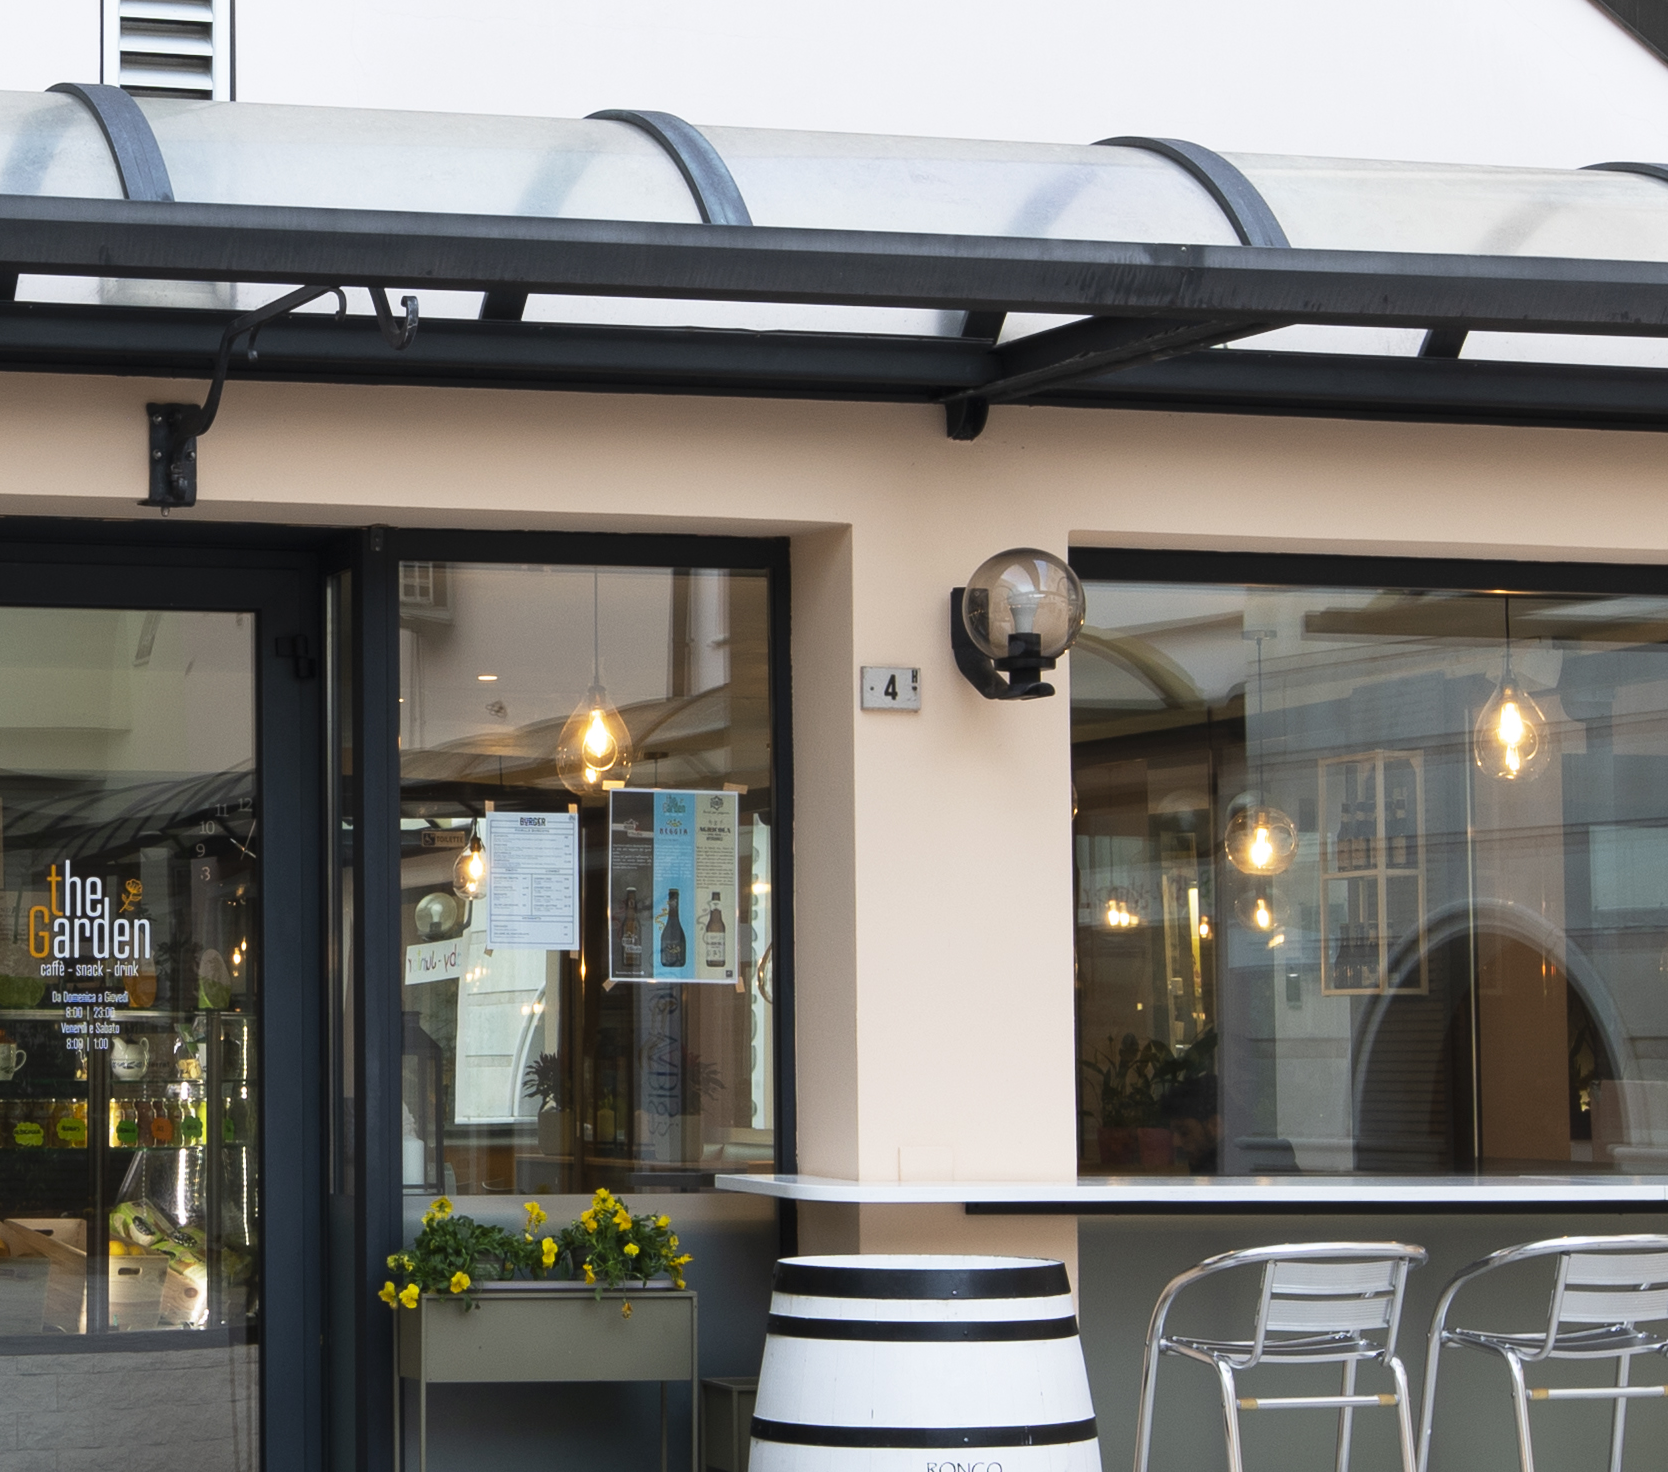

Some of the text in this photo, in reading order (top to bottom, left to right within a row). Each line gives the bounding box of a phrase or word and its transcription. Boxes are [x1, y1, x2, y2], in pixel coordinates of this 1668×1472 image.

[884, 669, 918, 700] 4 H
[200, 820, 215, 834] 10
[520, 817, 546, 826] BURGER
[436, 835, 464, 843] TOILETTE
[47, 859, 102, 916] the
[29, 897, 150, 958] Garden
[40, 959, 65, 976] caffè
[76, 960, 104, 976] snack
[114, 960, 139, 976] drink
[63, 991, 96, 1003] Domenica
[96, 1022, 120, 1034] Sabato
